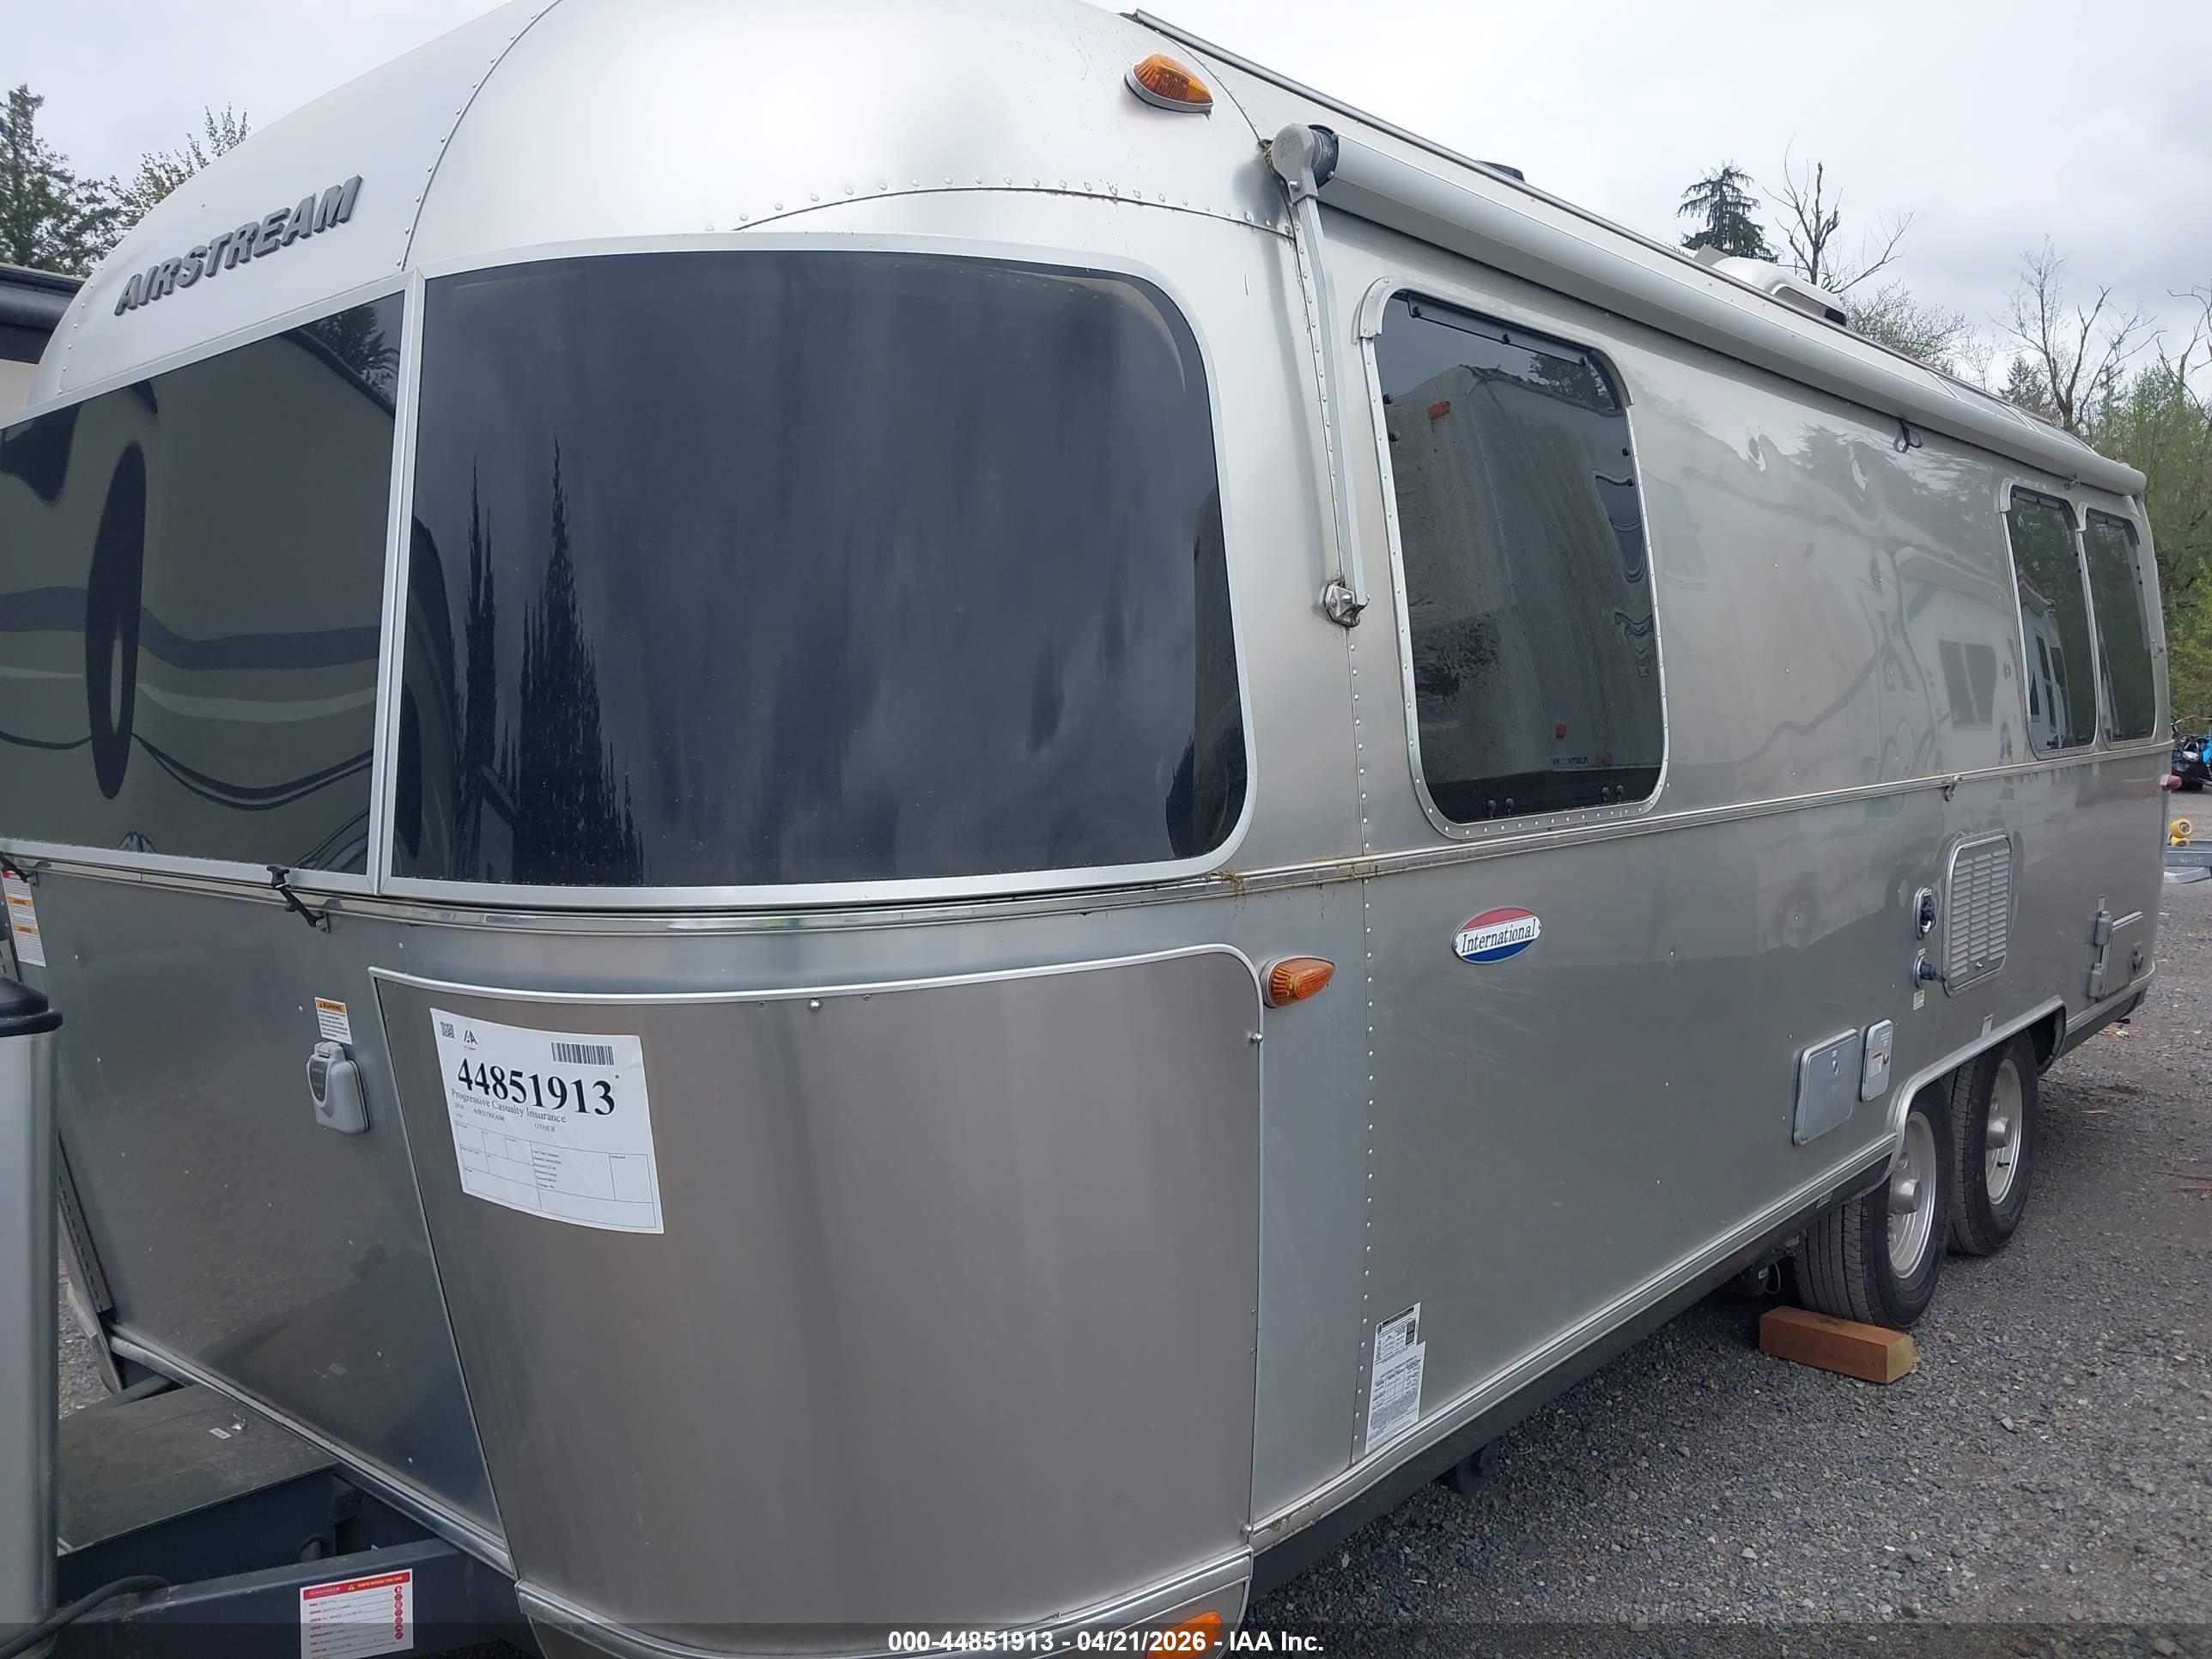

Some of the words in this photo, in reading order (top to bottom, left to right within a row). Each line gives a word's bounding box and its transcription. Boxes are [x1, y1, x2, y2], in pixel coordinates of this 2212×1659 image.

[113, 173, 362, 316] AIRSTREAM
[1461, 918, 1536, 953] International
[458, 1058, 615, 1115] 44851913
[451, 1088, 490, 1108] Progressive
[492, 1100, 524, 1117] Casualty
[526, 1108, 566, 1123] Insurance
[473, 1108, 505, 1121] AIRSTREAM
[534, 1122, 556, 1133] OTHER
